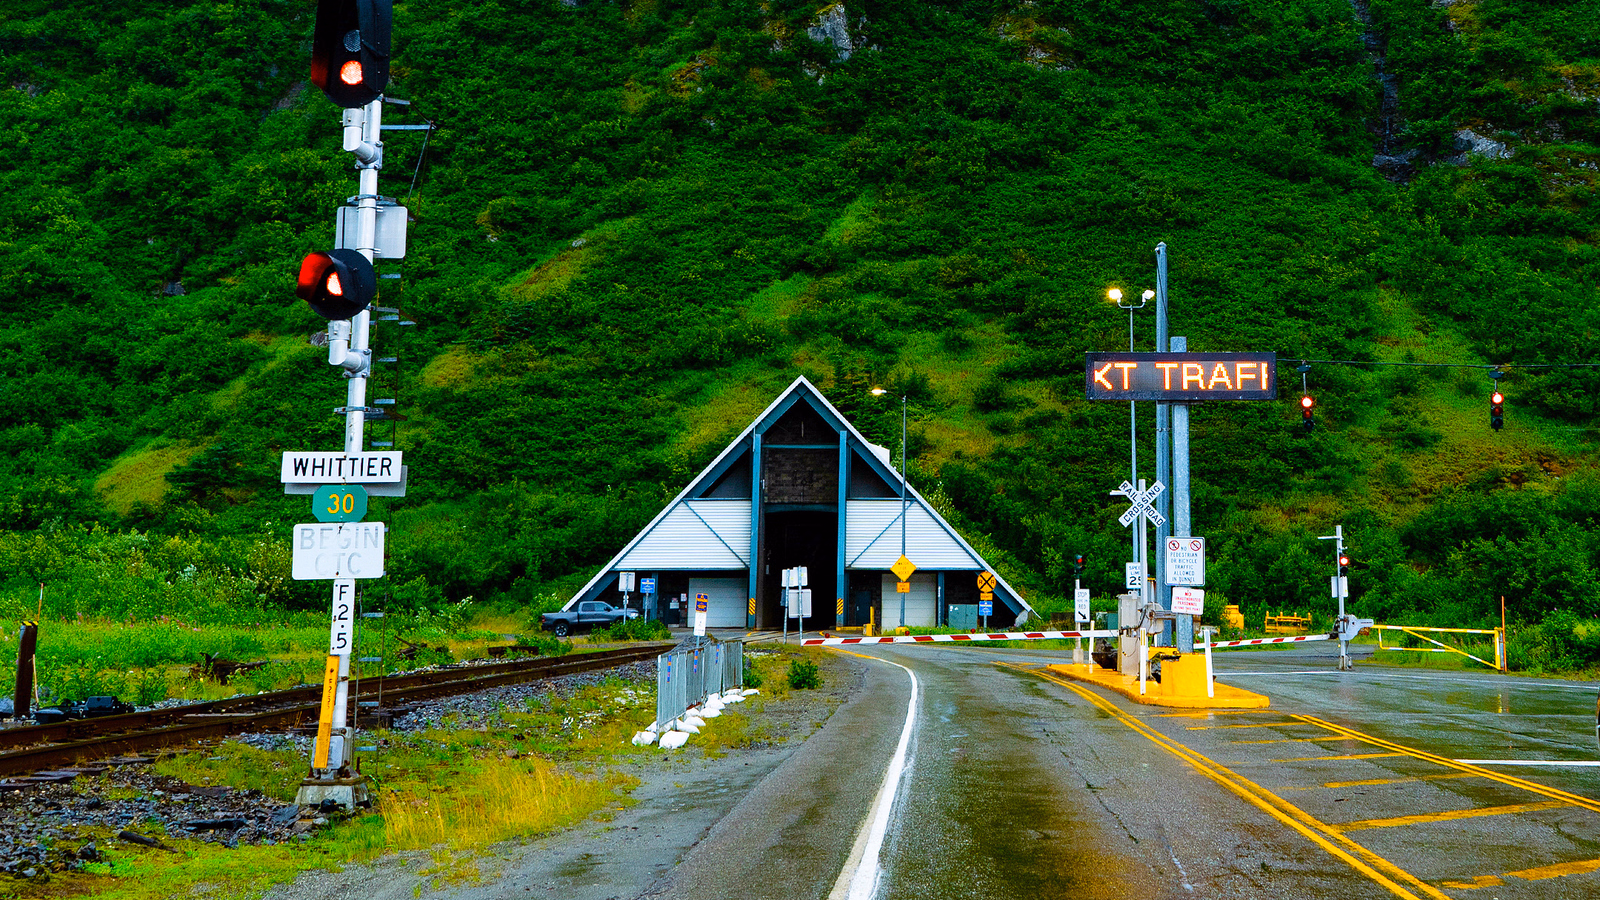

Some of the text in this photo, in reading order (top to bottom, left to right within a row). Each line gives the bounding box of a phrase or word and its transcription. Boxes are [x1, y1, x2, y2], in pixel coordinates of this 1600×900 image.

[293, 457, 392, 477] WHITTIER
[327, 493, 355, 514] 30
[1121, 482, 1164, 526] RAIL ROAD
[1123, 485, 1161, 523] CROSSING
[300, 525, 379, 550] BEGIN
[314, 551, 362, 576] CTC
